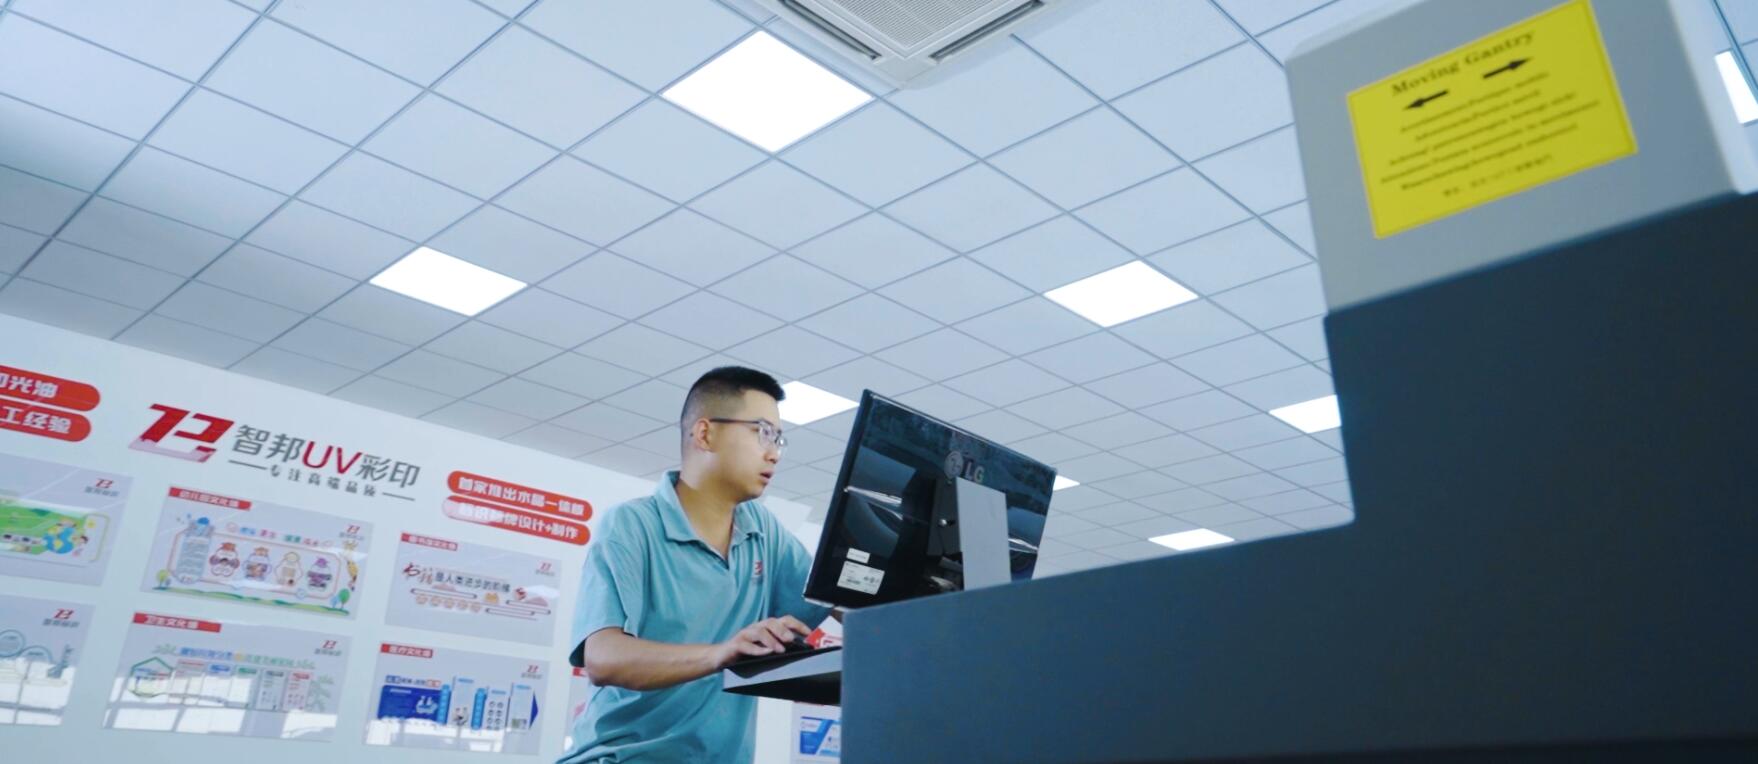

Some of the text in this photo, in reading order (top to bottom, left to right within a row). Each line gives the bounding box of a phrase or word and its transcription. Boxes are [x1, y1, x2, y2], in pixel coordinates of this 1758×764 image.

[1391, 31, 1536, 96] Moving Gantry
[964, 460, 985, 483] LG
